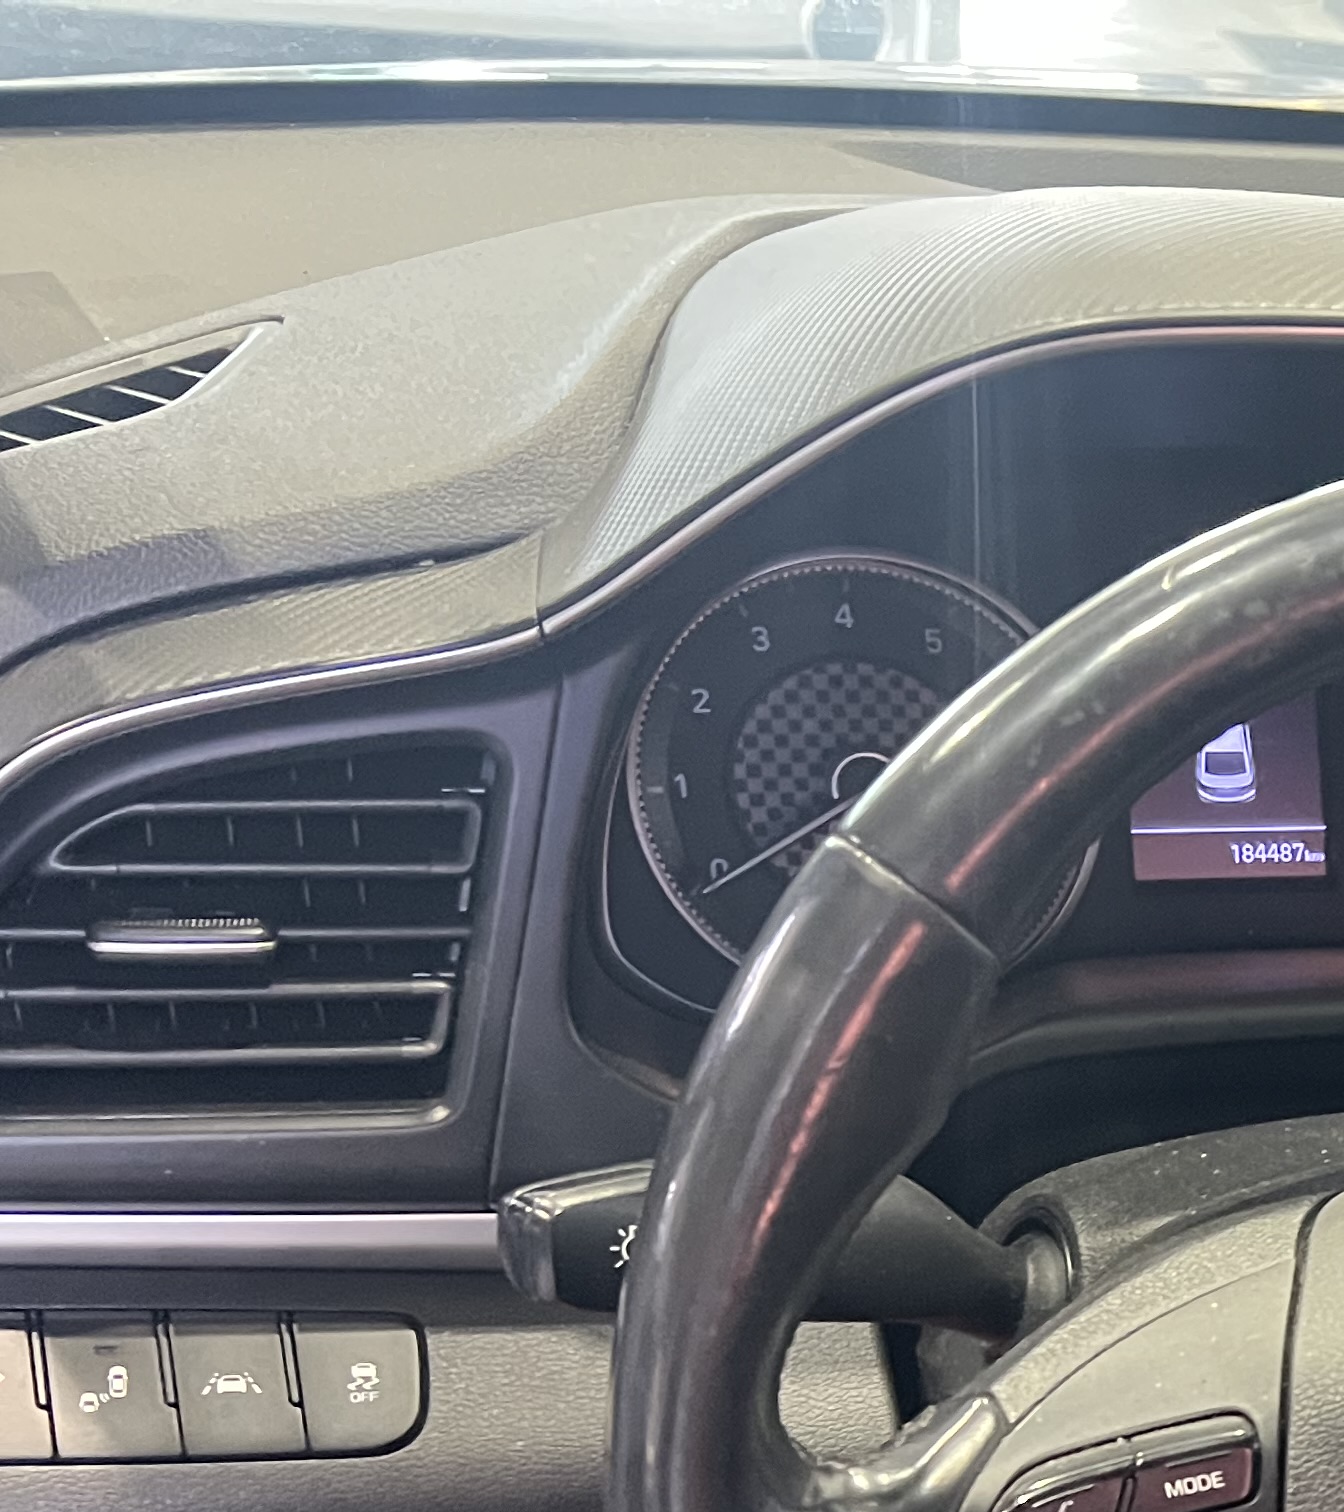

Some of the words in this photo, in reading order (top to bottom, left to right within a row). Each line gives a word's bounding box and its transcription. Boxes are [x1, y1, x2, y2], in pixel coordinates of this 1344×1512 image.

[834, 603, 854, 629] 4
[750, 625, 770, 652] 3
[923, 628, 943, 654] 5
[691, 688, 712, 713] 2
[673, 772, 688, 799] 1
[350, 1391, 380, 1403] OFF
[1163, 1470, 1227, 1499] MODE
